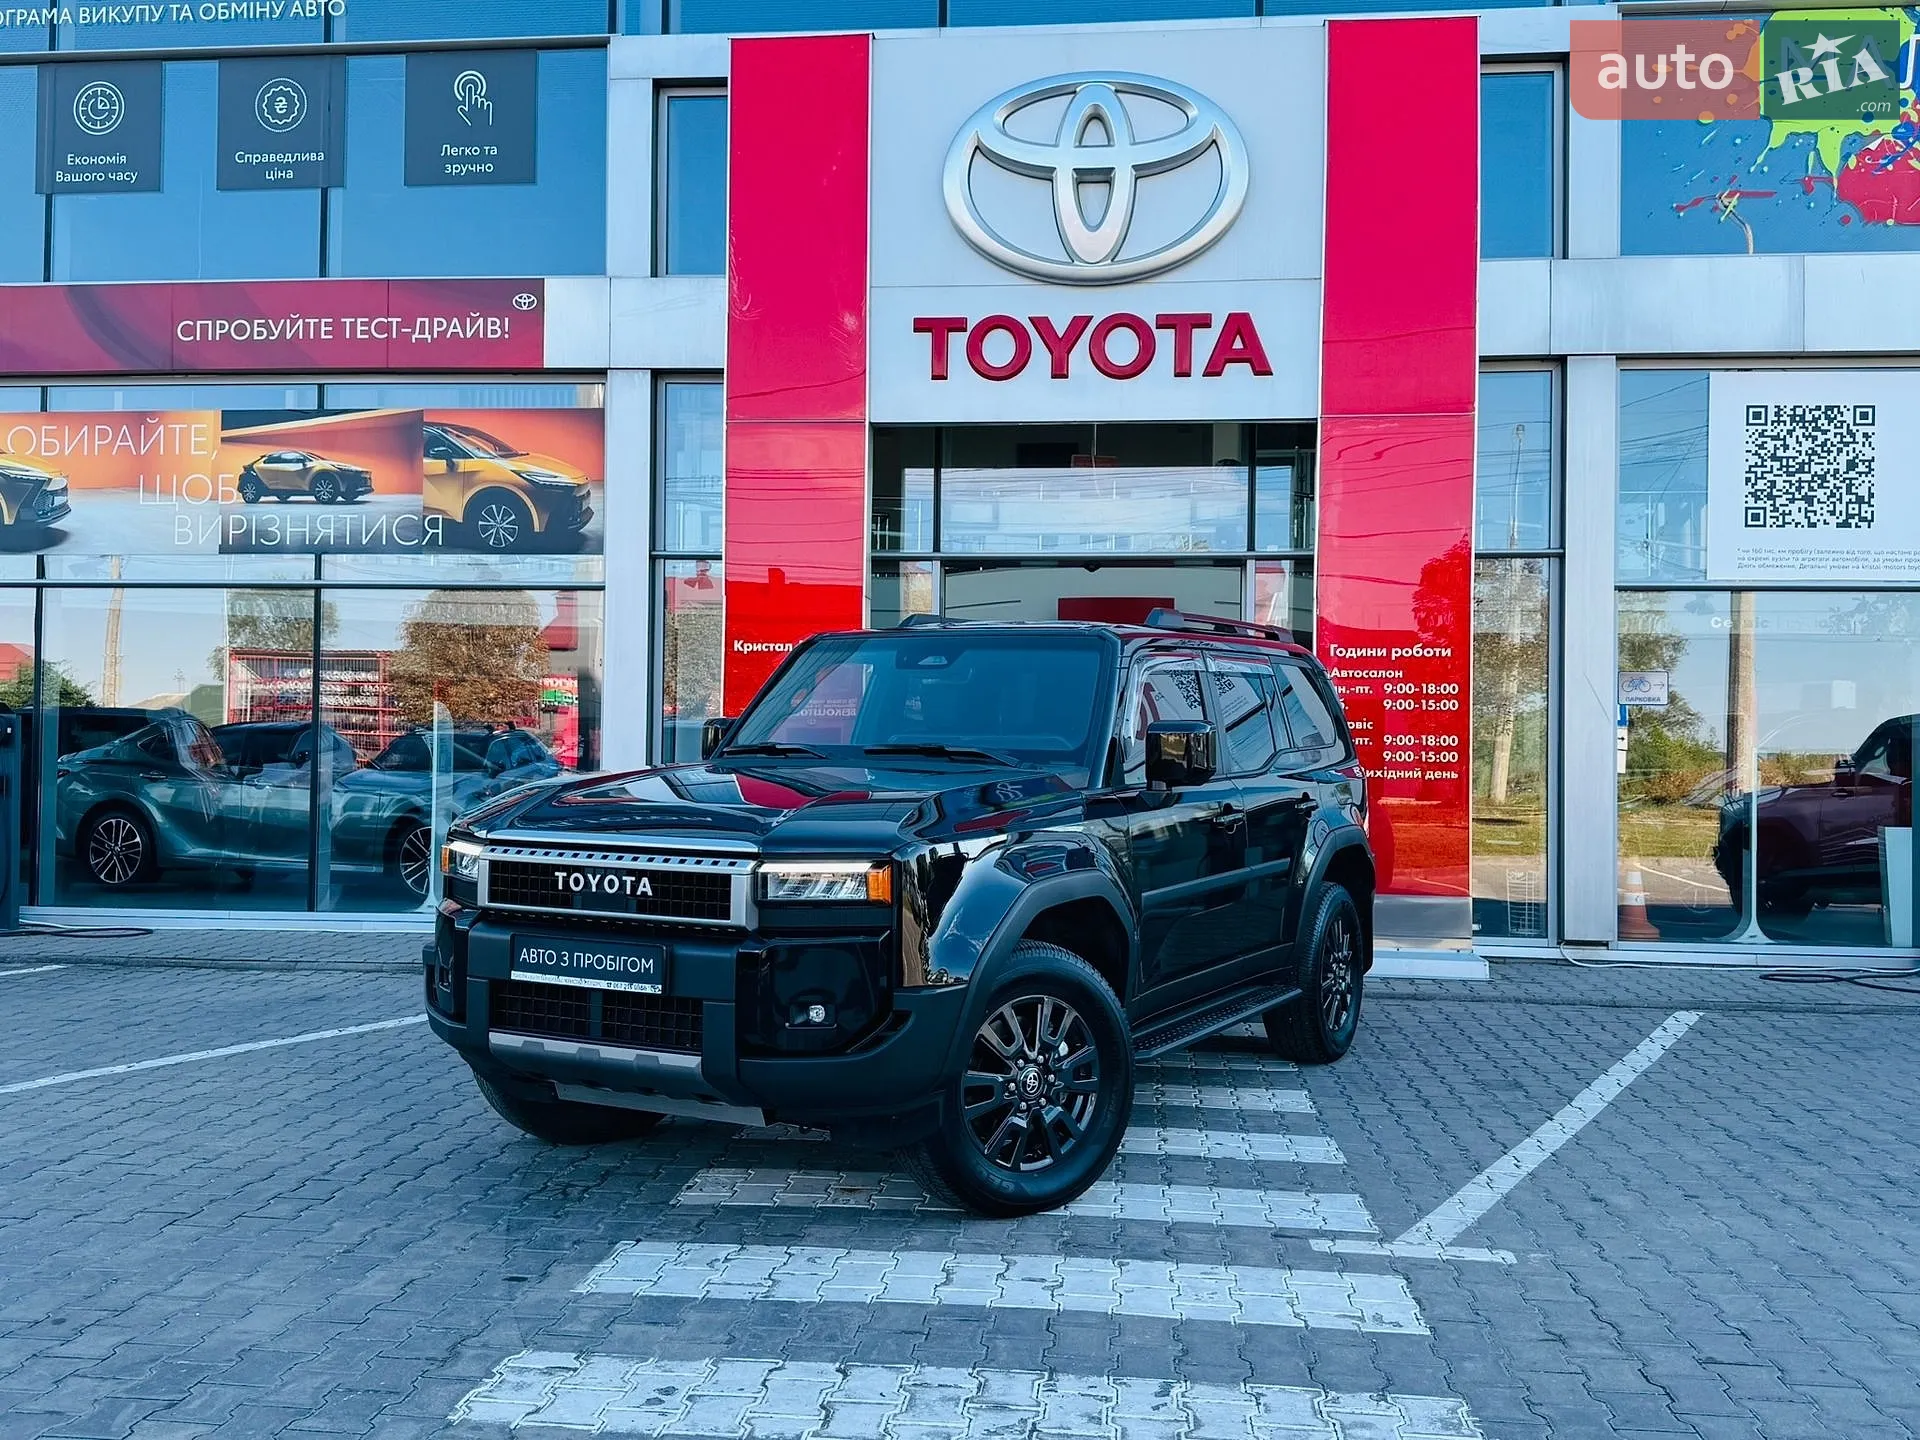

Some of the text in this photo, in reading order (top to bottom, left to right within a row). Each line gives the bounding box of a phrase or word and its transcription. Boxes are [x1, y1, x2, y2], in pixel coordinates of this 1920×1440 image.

[79, 4, 163, 24] ВИКУПУ
[170, 3, 195, 21] ТА
[200, 2, 284, 21] ОБМІНУ
[289, 0, 346, 18] АВТО
[234, 150, 325, 164] Справедлива
[440, 143, 498, 157] Легко та
[67, 152, 127, 166] Економія
[265, 167, 294, 181] ціна
[444, 161, 494, 175] зручно
[55, 168, 138, 184] Вашого часу
[176, 312, 511, 342] СПРОБУЙТЕ ТЕСТ-ДРАЙВ!
[913, 312, 1273, 381] TOYOTA
[7, 418, 218, 460] ОБИРАЙТЕ,
[138, 473, 238, 507] ЩОБ
[174, 514, 445, 546] ВИРІЗНЯТИСЯ
[734, 640, 793, 654] Кристал
[1329, 643, 1452, 660] Години роботи
[1330, 667, 1403, 679] Автосалон
[1383, 683, 1460, 695] 9:00-18:00
[1383, 699, 1460, 711] 9:00-15:00
[1383, 735, 1459, 747] 9:00-18:00
[1382, 751, 1459, 763] 9:00-15:00
[1424, 769, 1459, 780] день
[554, 871, 653, 896] TOYOTA
[519, 947, 557, 966] АВТО
[573, 953, 654, 974] ПРОБІГОМ
